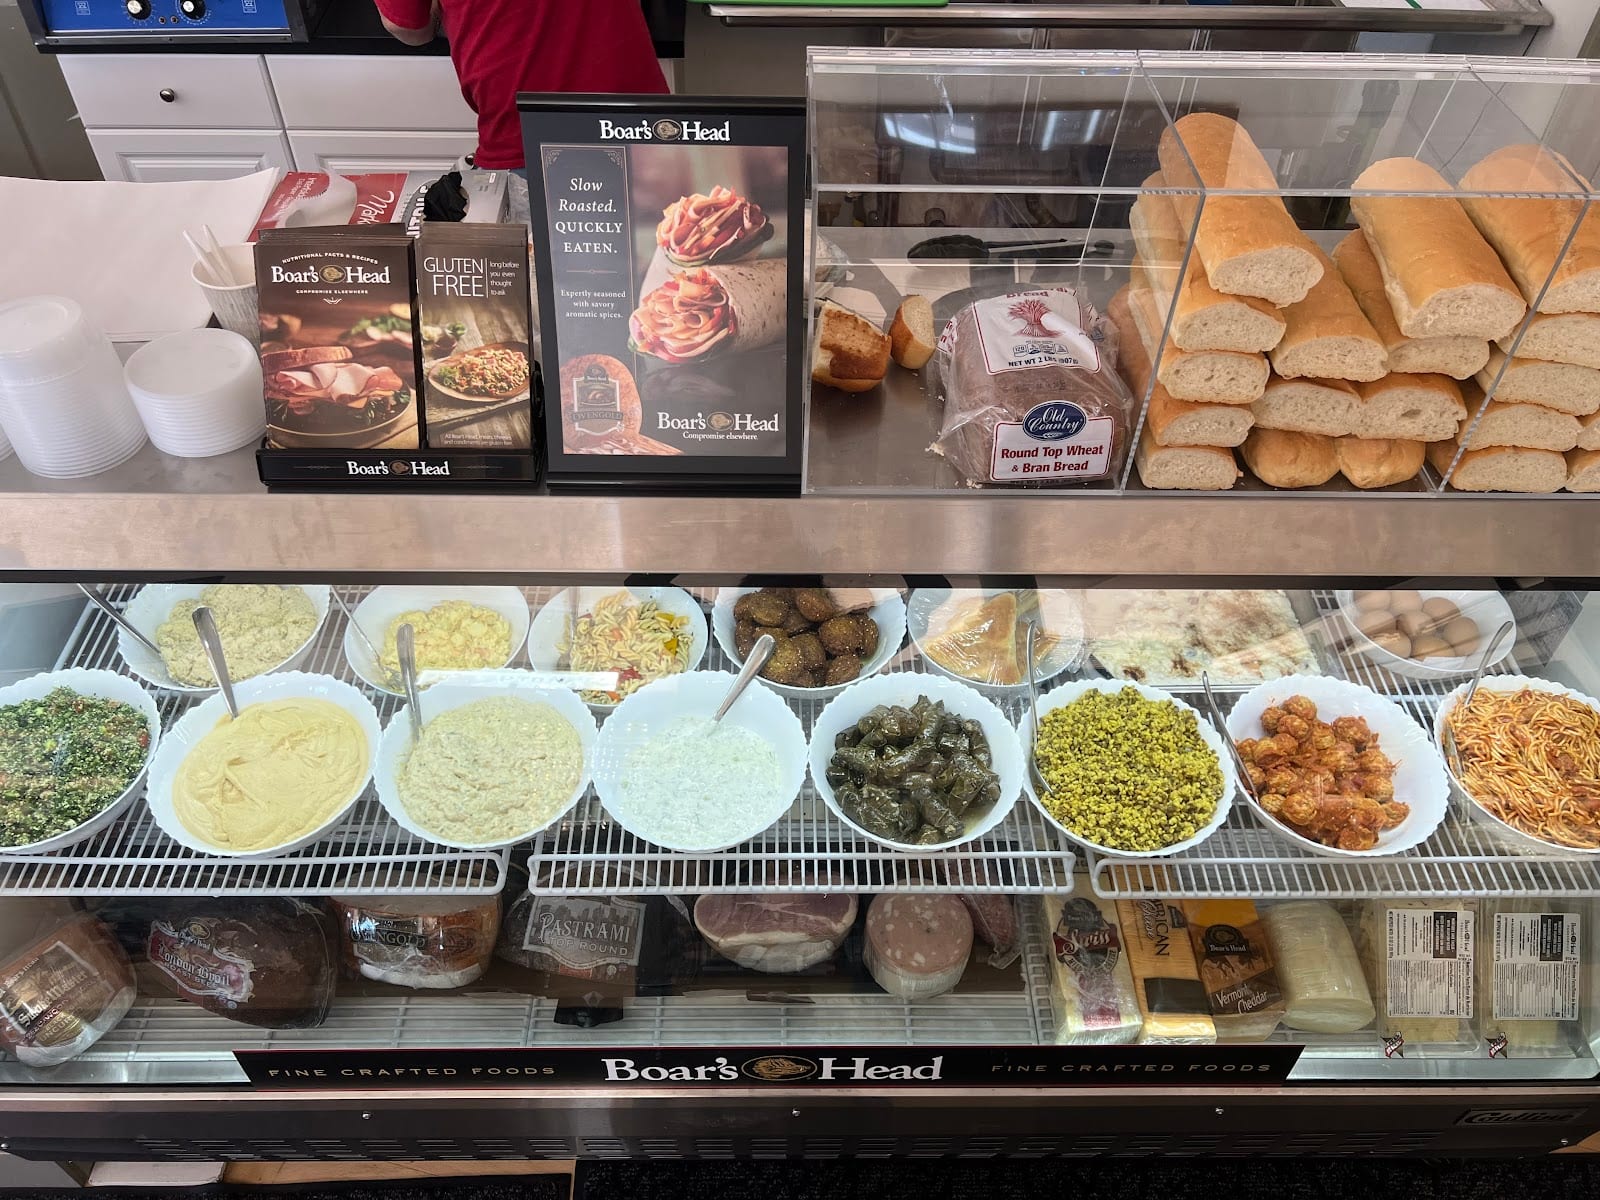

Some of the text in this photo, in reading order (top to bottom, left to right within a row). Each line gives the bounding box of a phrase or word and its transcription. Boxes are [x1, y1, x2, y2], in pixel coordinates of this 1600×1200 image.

[599, 119, 730, 141] Boar's Head
[570, 177, 602, 191] Slow
[559, 198, 617, 212] Roasted.
[555, 221, 623, 234] QUICKLY
[563, 242, 618, 254] EATEN.
[282, 252, 323, 264] NUTRITIONAL
[352, 254, 379, 265] RECIPES
[423, 256, 484, 274] GLUTEN
[490, 261, 520, 269] long before
[271, 265, 391, 284] Boar's Head
[433, 274, 484, 297] FREE
[490, 280, 512, 288] thought
[560, 289, 627, 299] Expertly seasoned
[573, 300, 615, 310] with savory
[565, 311, 624, 320] aromatic spices.
[1008, 360, 1022, 368] NET
[657, 411, 779, 432] Boar's Head
[1042, 406, 1066, 423] Old
[1027, 417, 1080, 434] Country
[683, 431, 725, 441] Compromise
[1001, 445, 1104, 459] Round Top Wheat
[346, 460, 450, 476] Boar's Head
[1011, 461, 1089, 473] & Bran Bread
[538, 912, 631, 943] PASTRAMI
[1154, 898, 1170, 957] ERICAN
[549, 937, 629, 956] TOP ROUND
[1058, 928, 1112, 957] Swiss
[1216, 983, 1250, 1008] Vermont
[1238, 991, 1267, 1015] Cheddar
[269, 1056, 1272, 1081] FINE CRAFTED FOODS Boar's Head FINE CRAFTED FOODS
